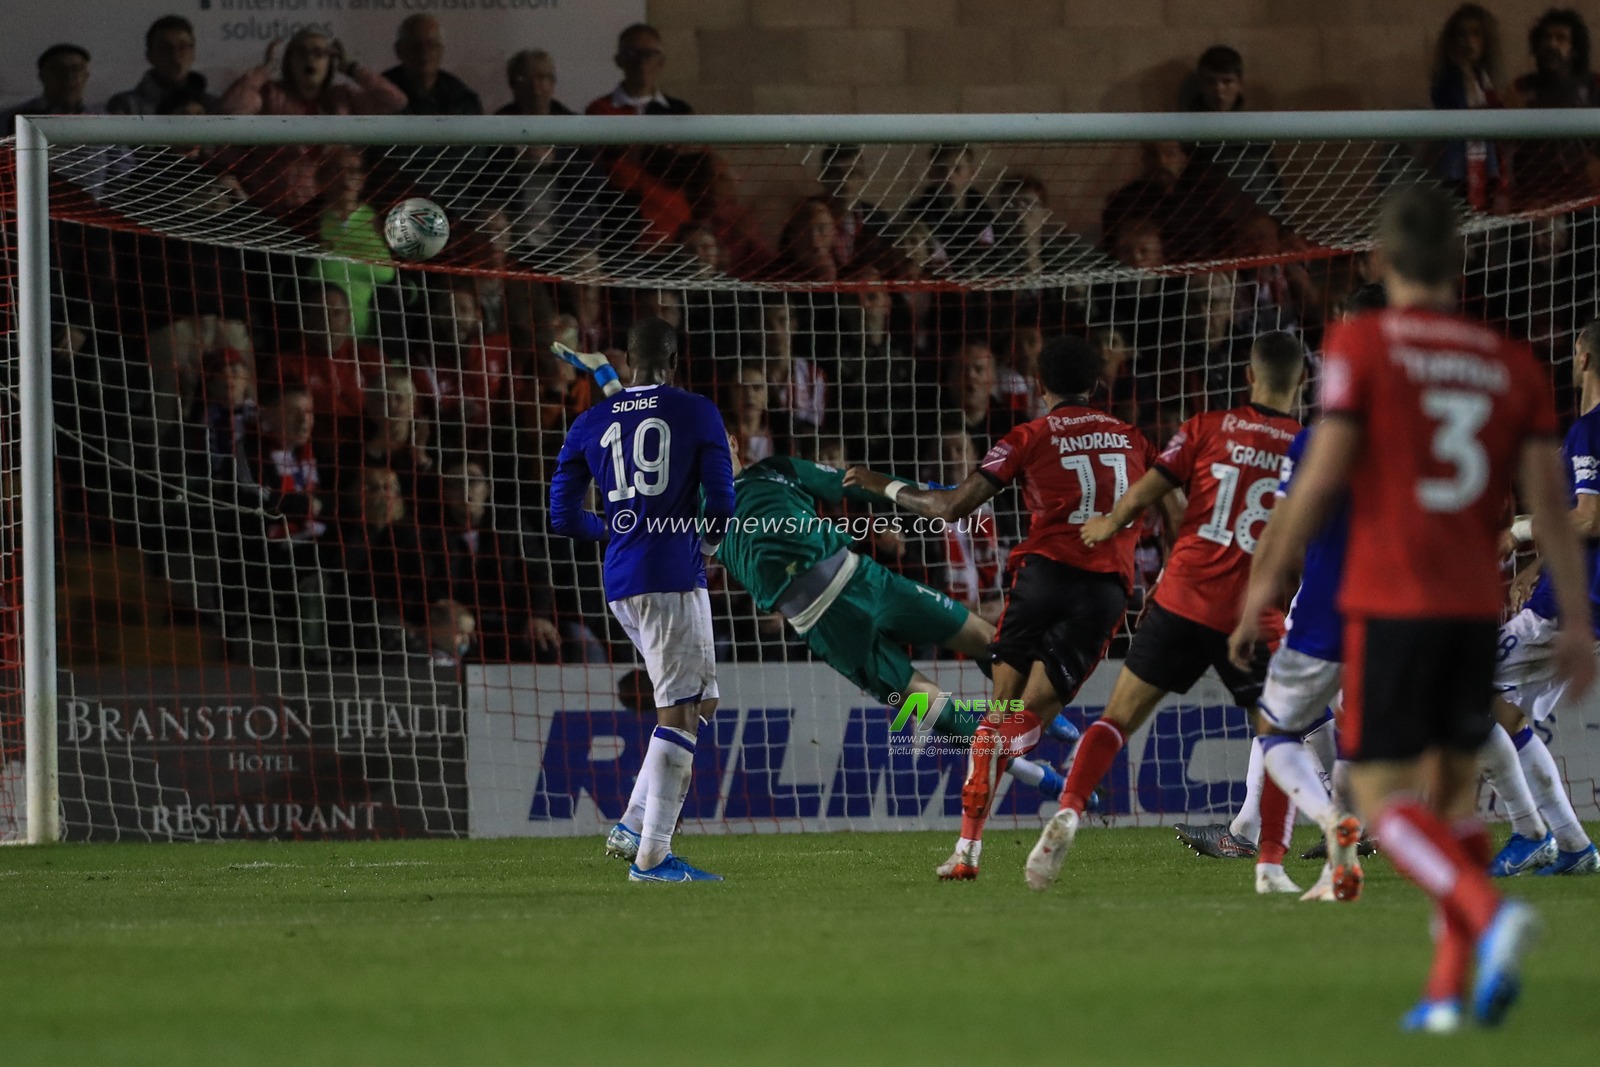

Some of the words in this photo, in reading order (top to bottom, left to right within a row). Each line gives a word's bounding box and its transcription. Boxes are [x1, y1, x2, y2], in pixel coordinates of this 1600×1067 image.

[611, 396, 659, 414] SIDIBE
[1059, 432, 1133, 454] ANDRADE
[1416, 388, 1493, 514] 3
[600, 417, 672, 503] 19
[1231, 445, 1288, 472] GRAN
[1197, 462, 1281, 555] 18
[915, 584, 942, 602] 1
[66, 701, 312, 743] BRANSTON
[341, 698, 466, 739] HALL
[228, 751, 299, 772] HOTEL
[151, 801, 382, 835] RESTAURANT
